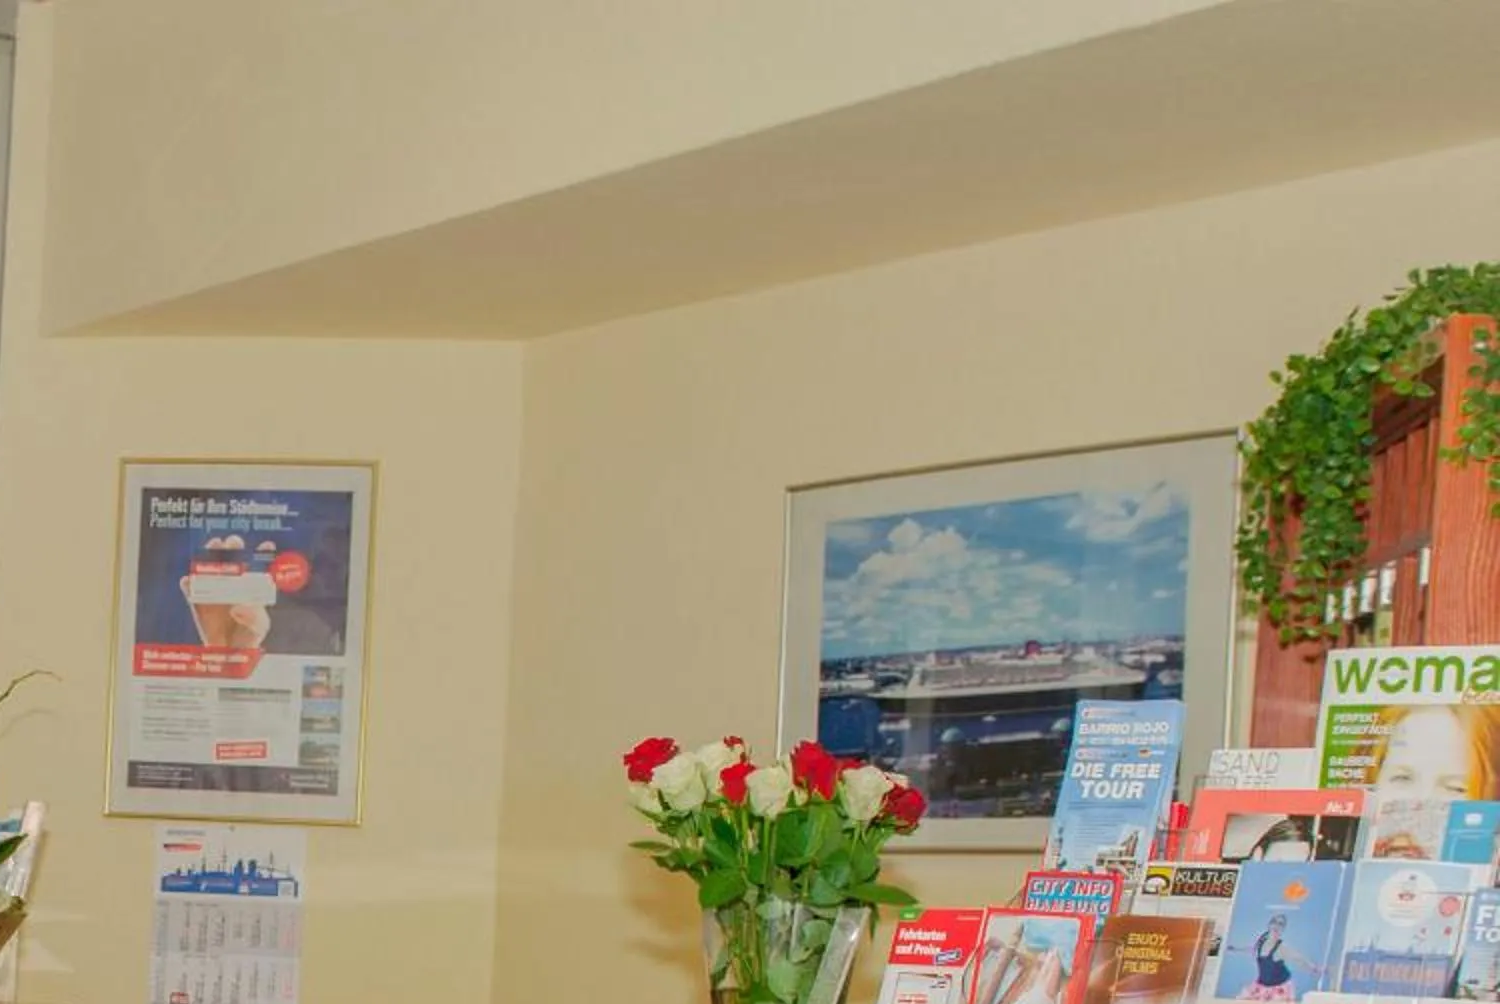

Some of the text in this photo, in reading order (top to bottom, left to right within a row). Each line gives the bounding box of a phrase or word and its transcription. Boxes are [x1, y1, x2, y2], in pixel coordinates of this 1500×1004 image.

[1071, 762, 1162, 779] DIE FREE
[1080, 781, 1146, 799] TOUR
[1030, 878, 1114, 897] CITY INFO
[1126, 932, 1169, 946] ENJOY
[1122, 962, 1159, 974] FILMS
